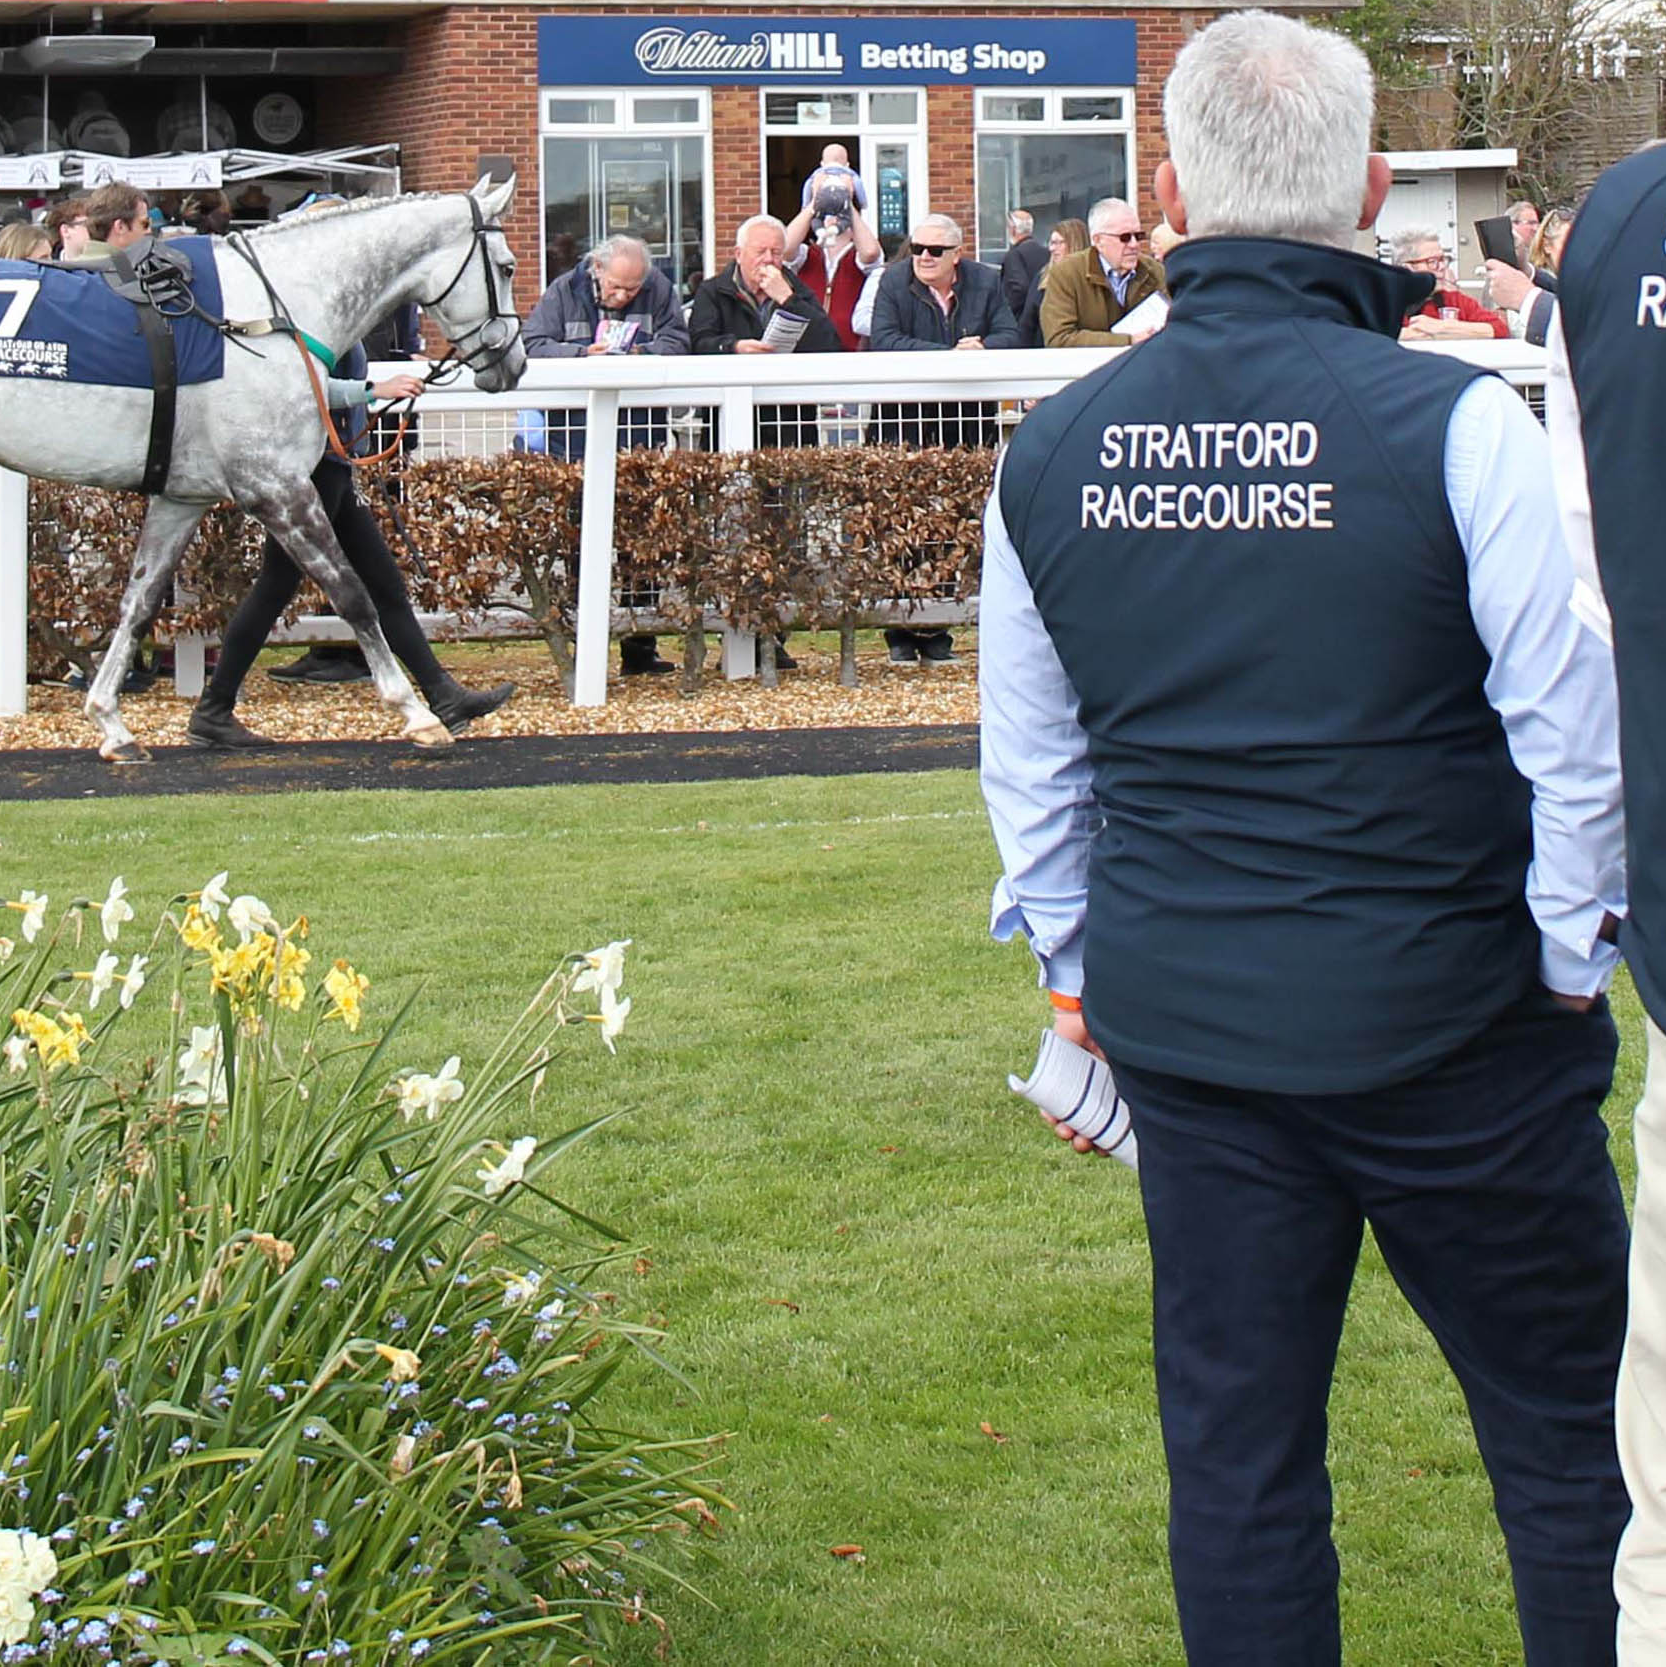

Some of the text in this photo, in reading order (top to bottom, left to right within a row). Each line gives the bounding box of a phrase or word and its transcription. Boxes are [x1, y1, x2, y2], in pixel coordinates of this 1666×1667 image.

[635, 27, 1045, 74] William HILL Betting Shop
[1100, 421, 1319, 469] STRATFORD
[1081, 483, 1334, 529] RACECOURSE
